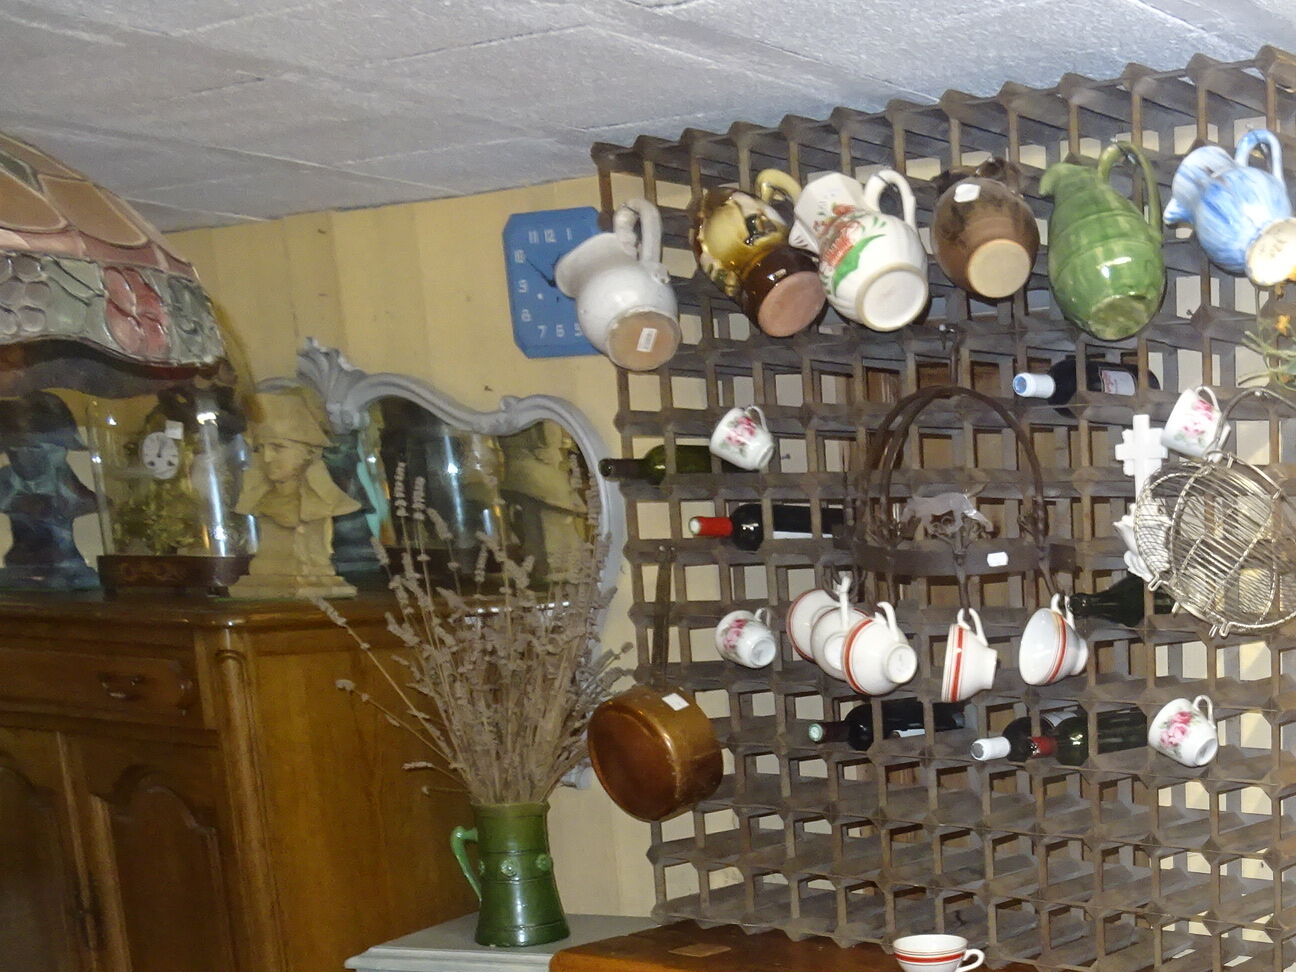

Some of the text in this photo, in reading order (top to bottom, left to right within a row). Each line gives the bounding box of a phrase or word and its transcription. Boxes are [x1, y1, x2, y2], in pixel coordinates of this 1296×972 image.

[544, 228, 557, 243] 12
[566, 227, 573, 241] 1
[518, 279, 528, 293] 9
[521, 309, 532, 322] 8
[537, 324, 548, 338] 7
[555, 324, 565, 337] 6
